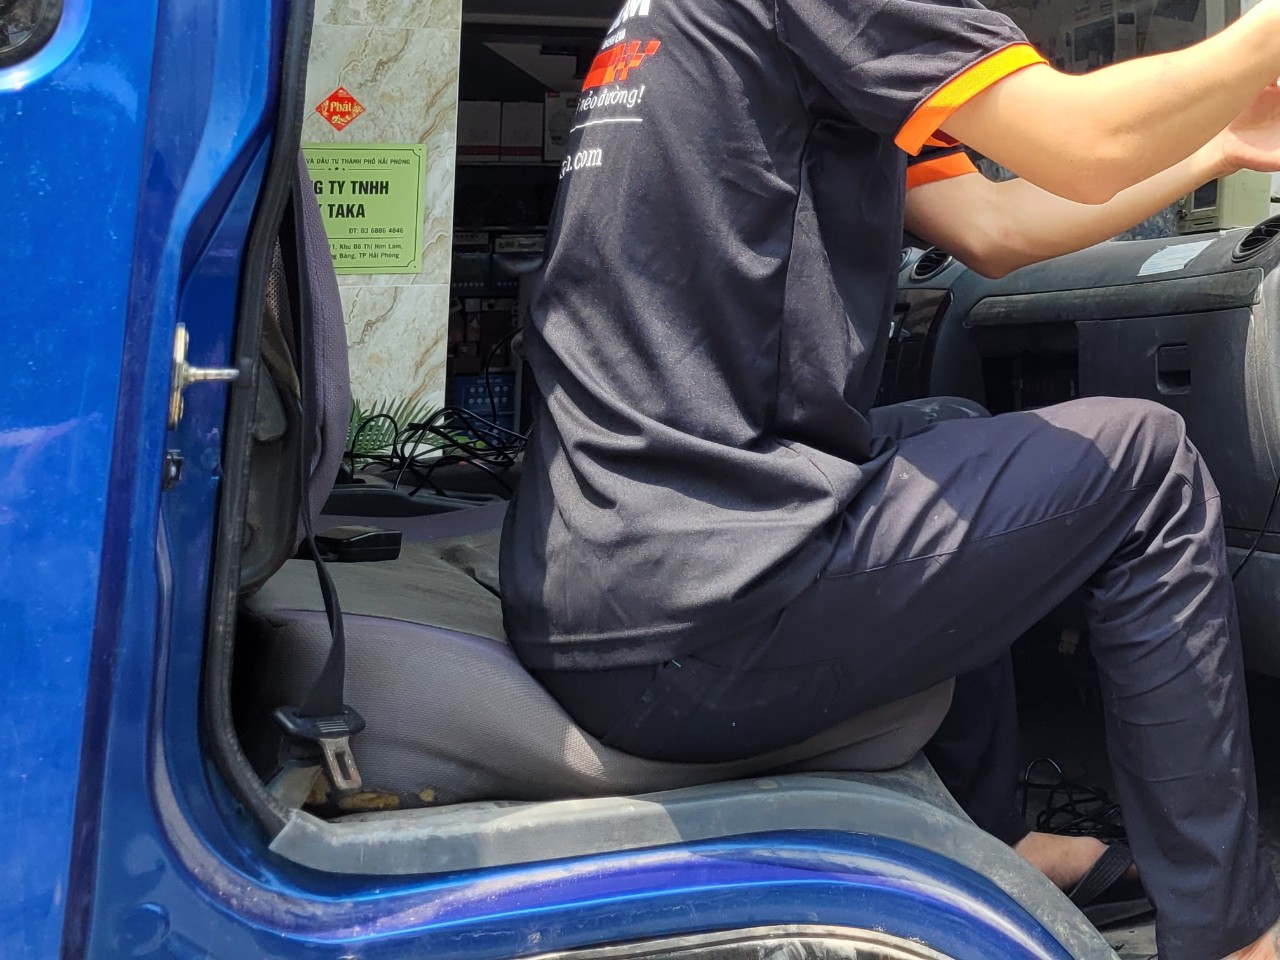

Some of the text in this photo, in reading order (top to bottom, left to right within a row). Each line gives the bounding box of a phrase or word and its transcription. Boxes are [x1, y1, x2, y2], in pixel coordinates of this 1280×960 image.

[597, 83, 646, 109] đường!
[328, 180, 346, 195] TY
[350, 180, 390, 195] TNHH
[327, 203, 366, 219] TAKA
